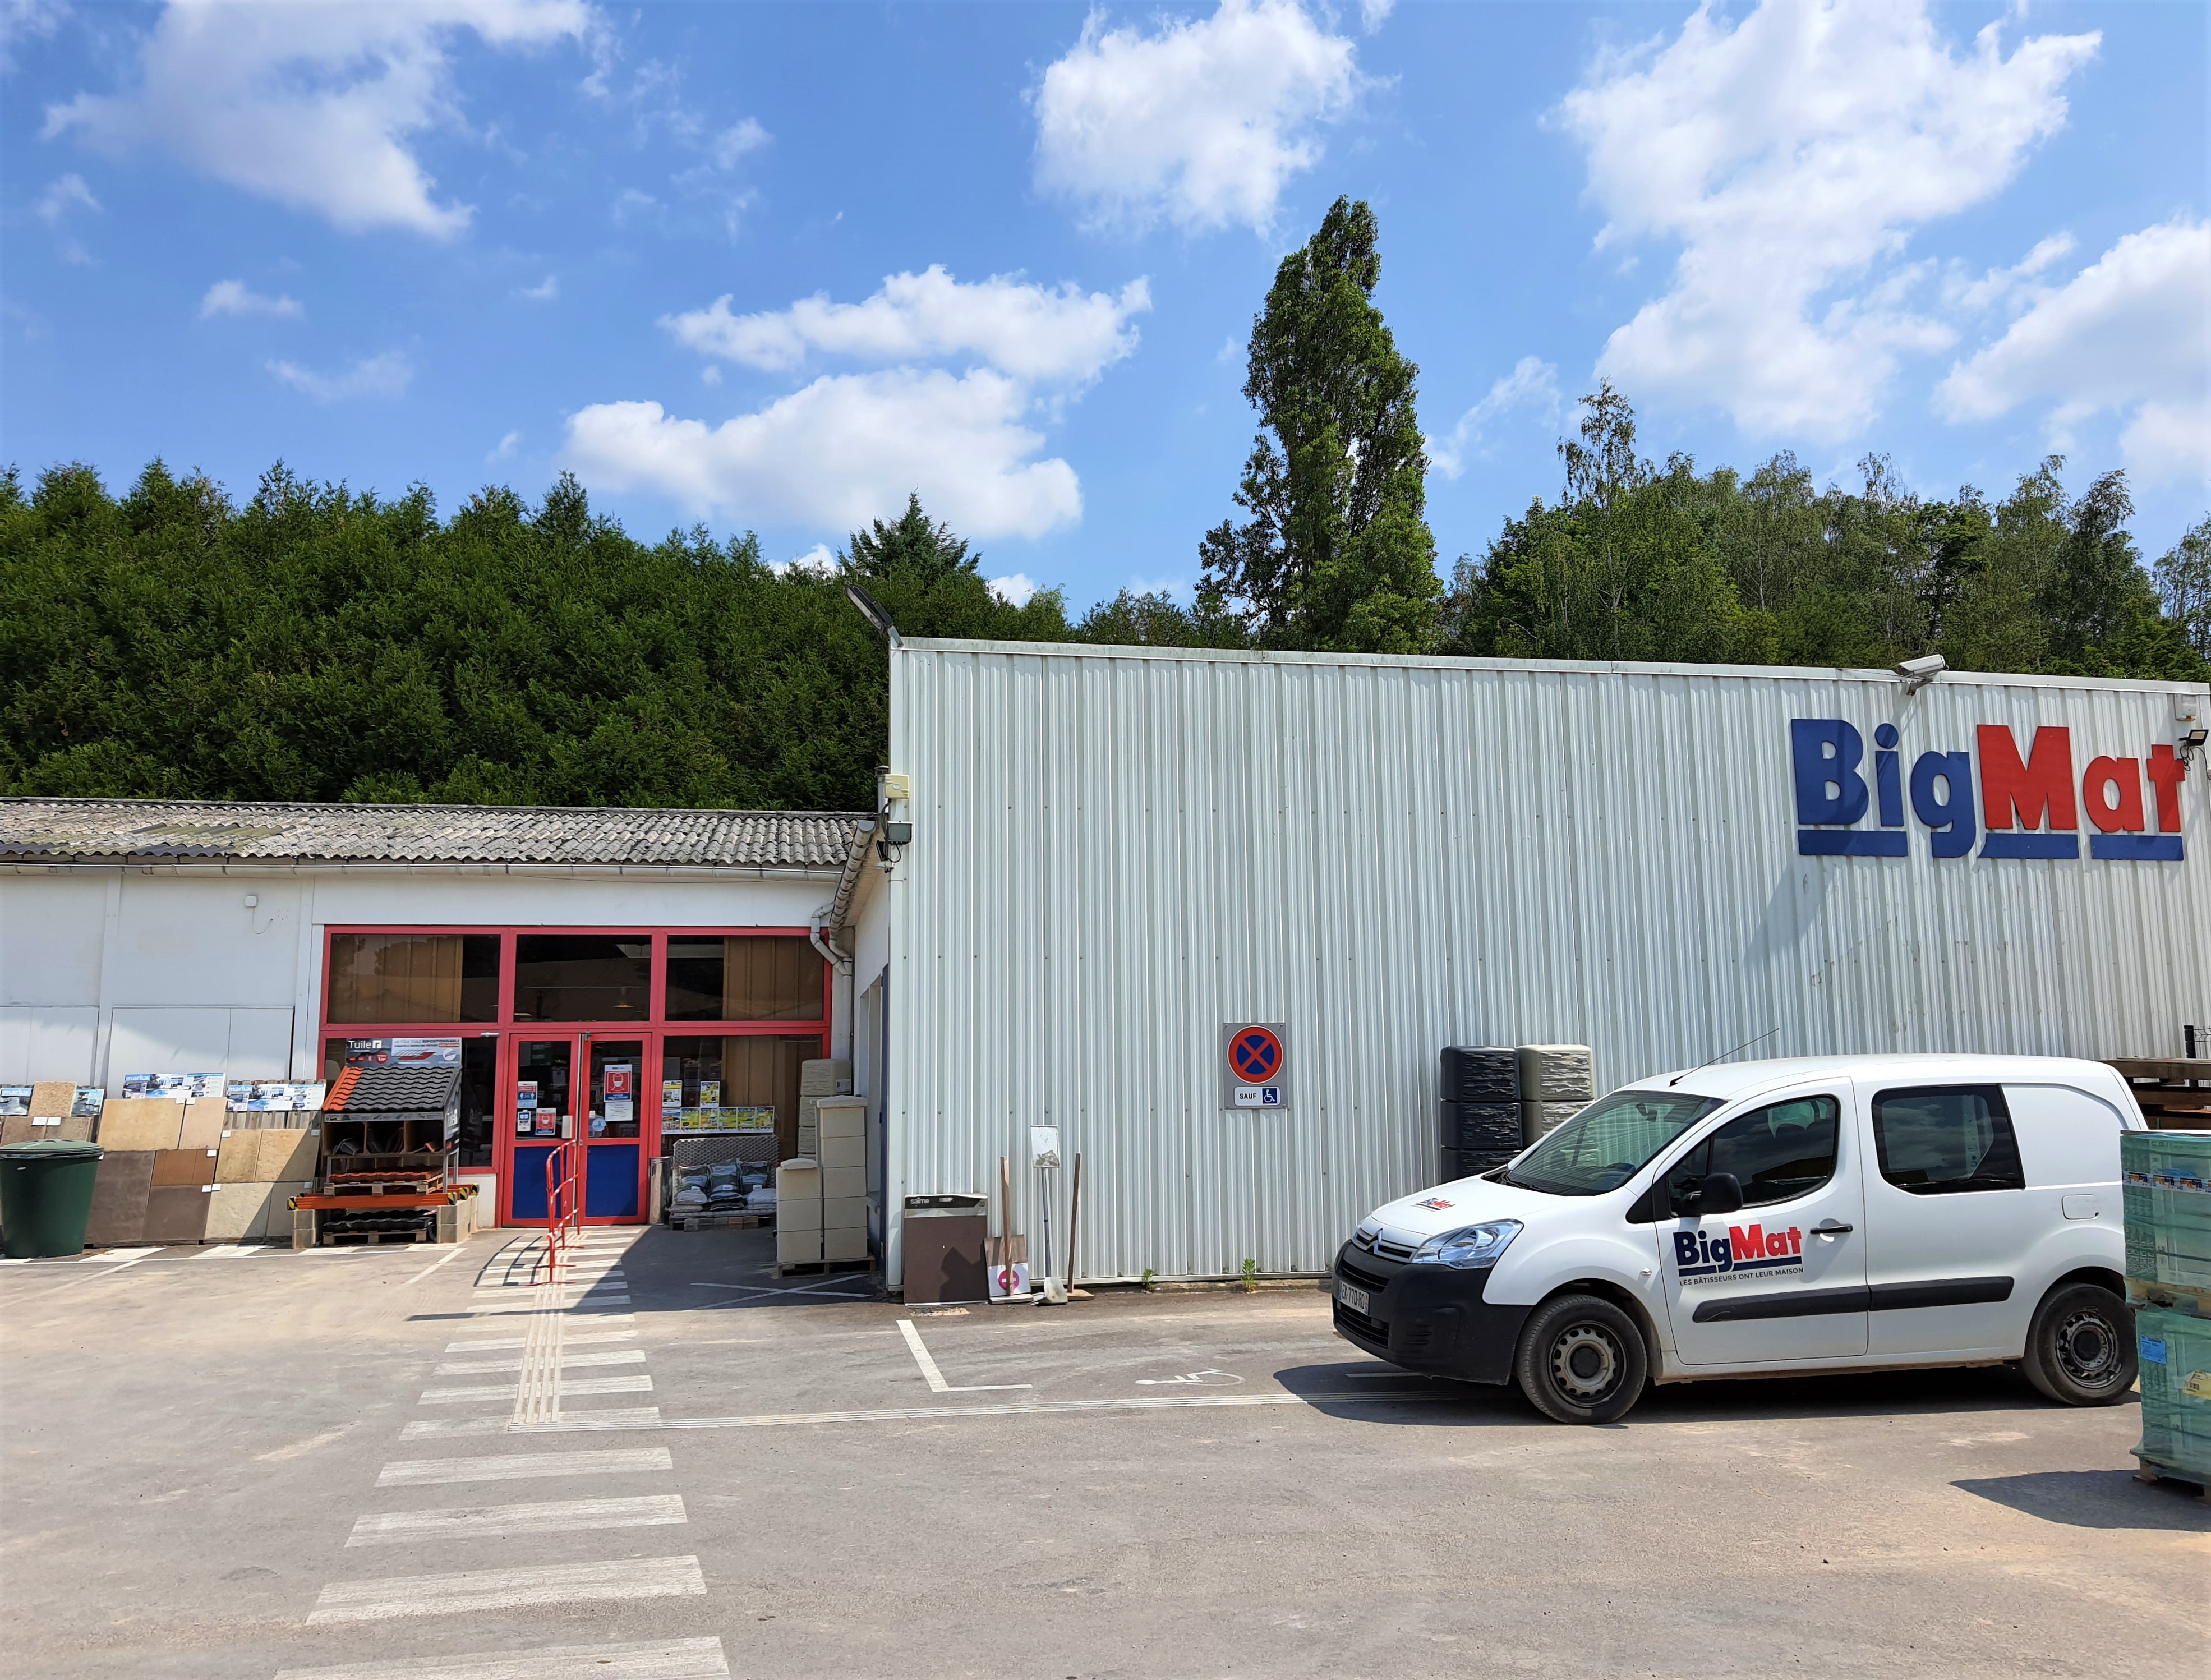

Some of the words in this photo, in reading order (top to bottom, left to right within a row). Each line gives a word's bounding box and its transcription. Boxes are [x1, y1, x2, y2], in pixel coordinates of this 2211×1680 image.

[1791, 719, 2185, 858] BigMat
[348, 1040, 371, 1048] Tuile
[1673, 1223, 1802, 1273] BigMat
[1694, 1274, 1737, 1285] BÂTISSEURS
[1775, 1267, 1804, 1276] MAISON
